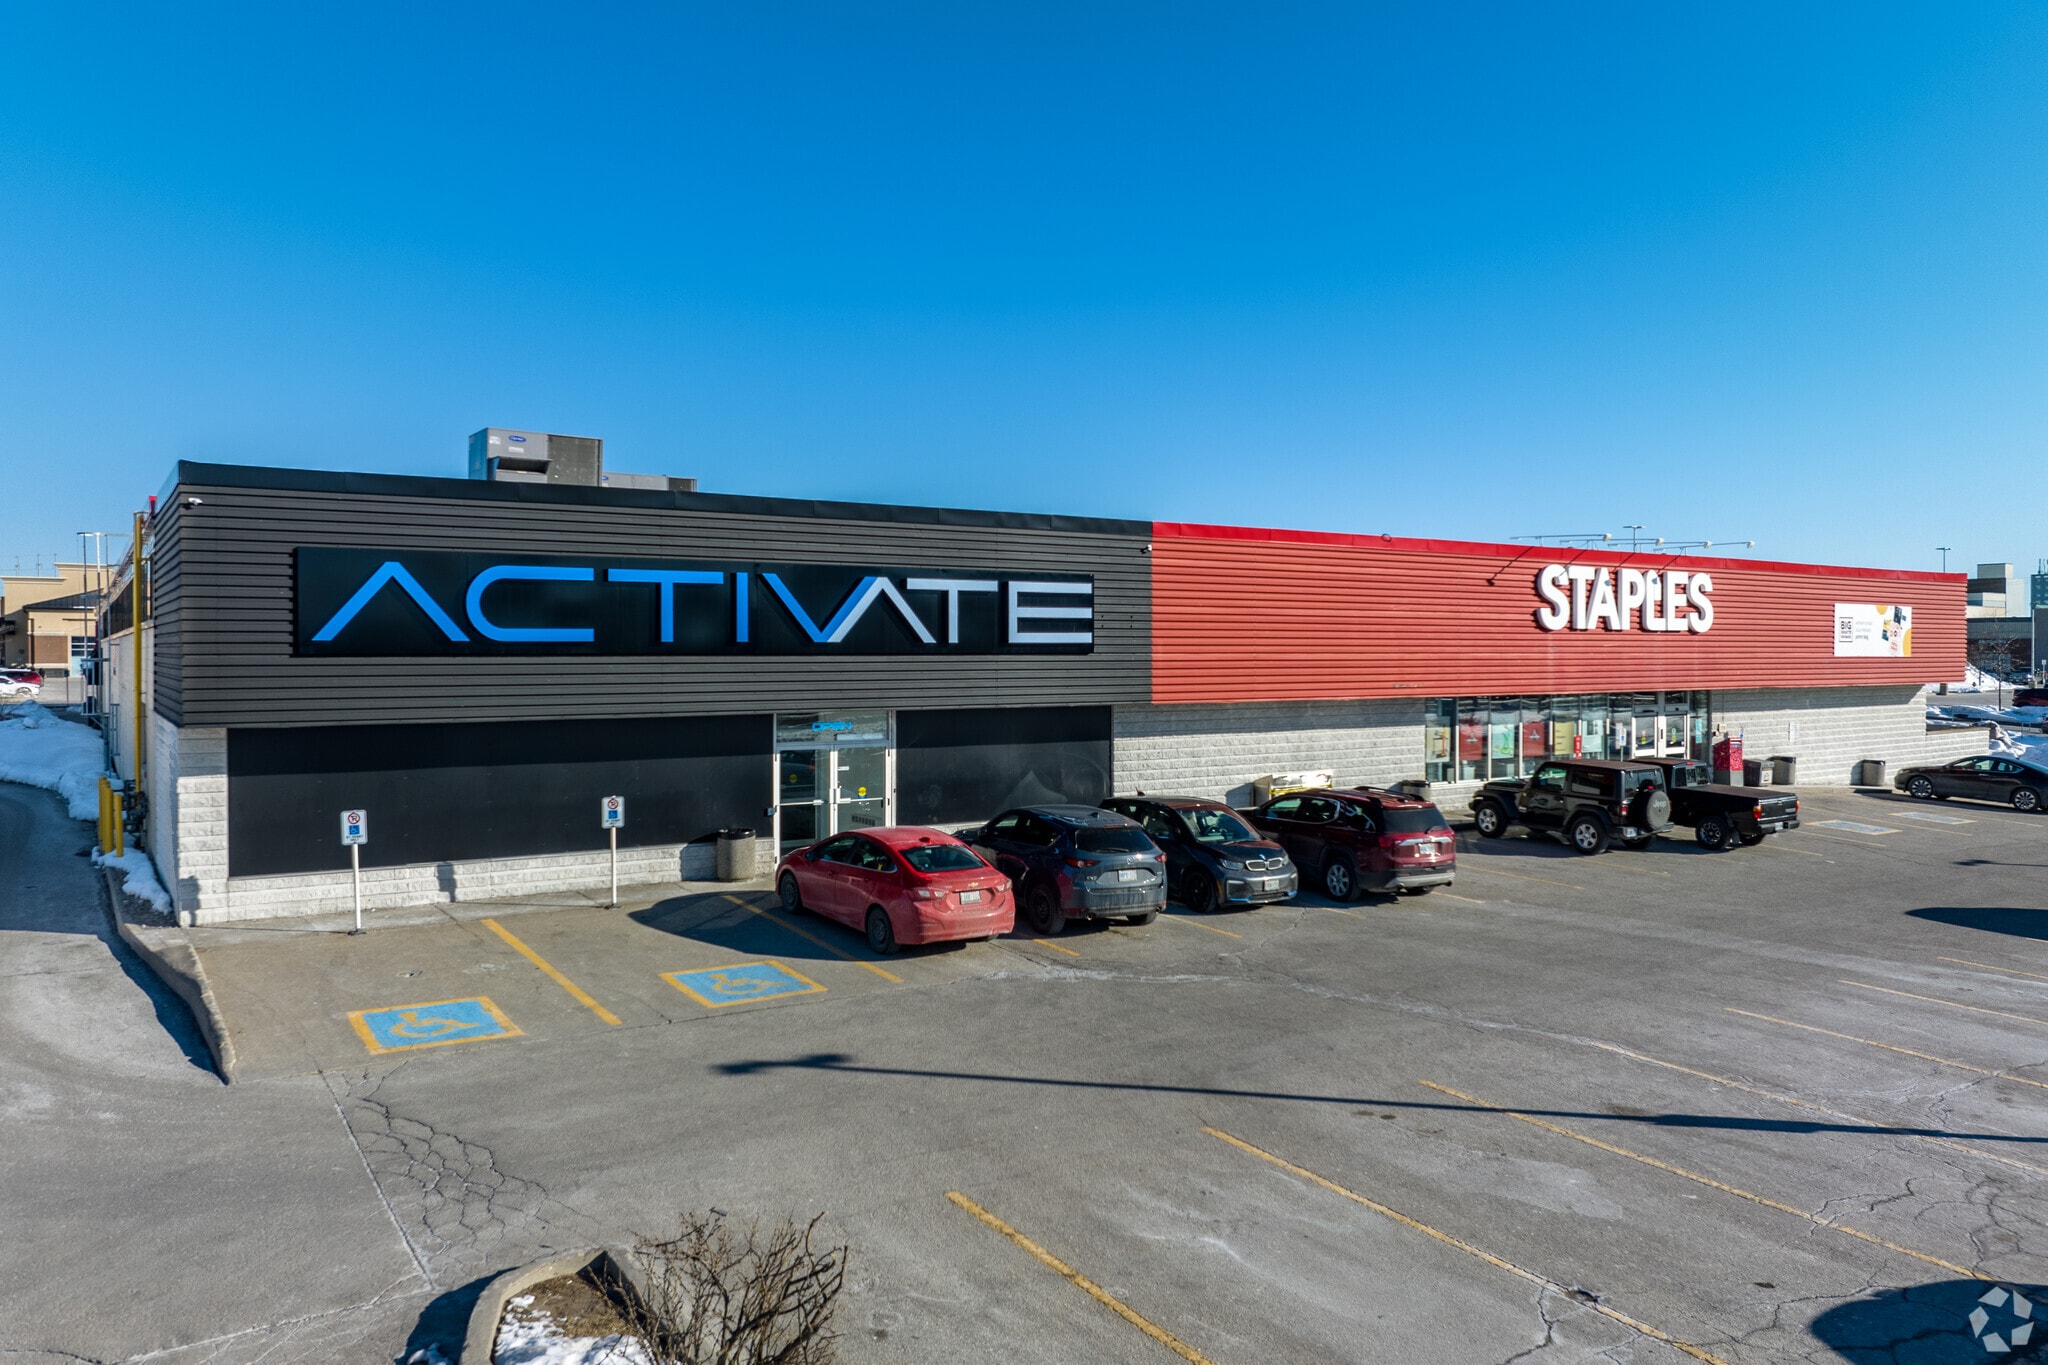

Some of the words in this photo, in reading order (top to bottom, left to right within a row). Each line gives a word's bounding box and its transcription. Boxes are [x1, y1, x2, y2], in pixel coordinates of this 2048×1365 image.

[311, 560, 1095, 645] ACTIVATE
[1534, 563, 1715, 634] STAPLES
[1840, 620, 1852, 630] BIG
[1653, 799, 1667, 808] Jeep
